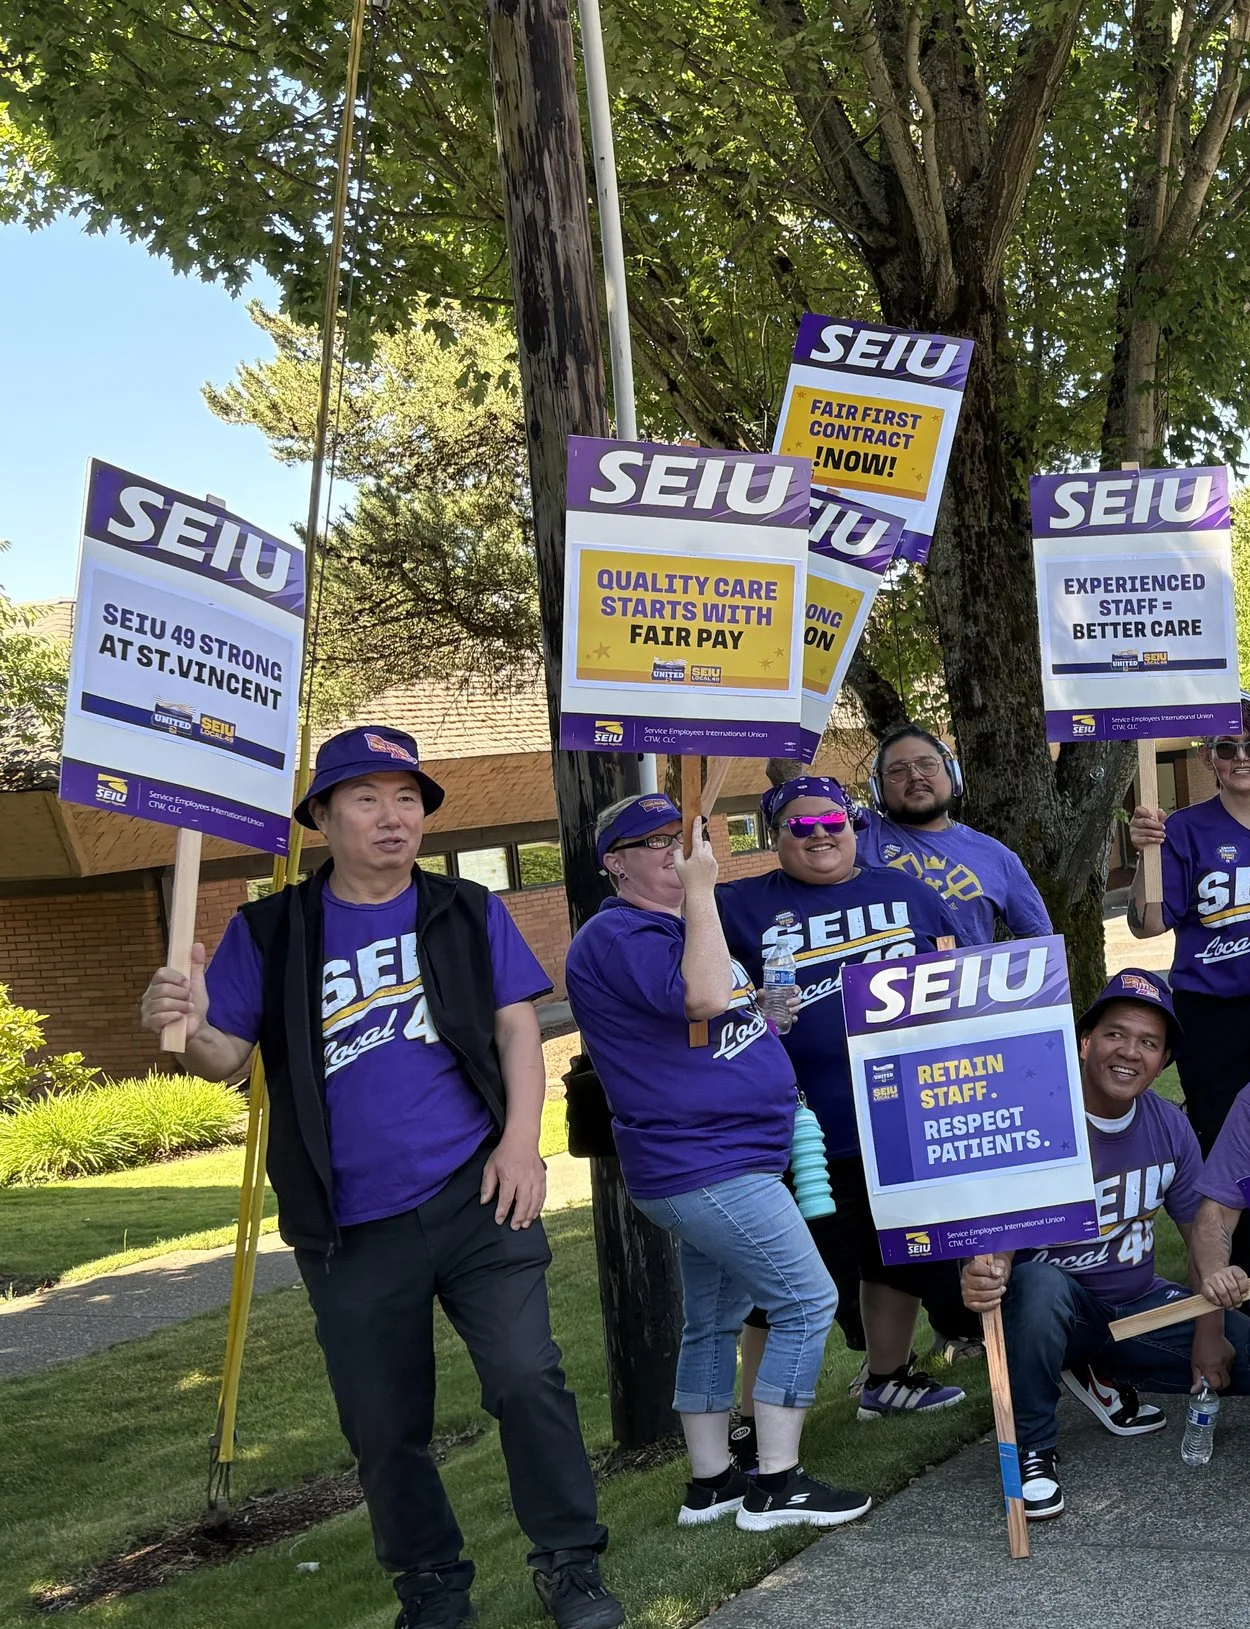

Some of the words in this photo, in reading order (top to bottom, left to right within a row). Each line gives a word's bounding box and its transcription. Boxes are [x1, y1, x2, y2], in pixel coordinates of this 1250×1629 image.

[809, 325, 960, 378] SEIU
[810, 399, 858, 420] FAIR
[861, 407, 922, 430] FIRST
[809, 421, 914, 450] CONTRACT
[814, 446, 897, 477] !NOW!
[590, 450, 793, 515] SEIU
[1050, 475, 1213, 530] SEIU
[107, 486, 291, 593] SEIU
[597, 569, 709, 595] QUALITY
[714, 578, 777, 600] CARE
[1064, 574, 1205, 594] EXPERIENCED
[601, 596, 697, 621] STARTS
[703, 603, 772, 626] WITH
[1099, 598, 1157, 616] STAFF
[103, 603, 166, 640] SEIU
[171, 625, 195, 649] 49
[199, 634, 282, 682] STRONG
[630, 624, 691, 646] FAIR
[697, 628, 744, 649] PAY
[1073, 622, 1146, 639] BETTER
[1150, 619, 1202, 637] CARE
[1144, 652, 1166, 661] SEIU
[99, 633, 133, 661] AT
[137, 645, 282, 710] ST.VINCENT
[692, 667, 720, 676] SEIU
[154, 714, 191, 729] UNITED
[201, 717, 234, 736] SEIU
[644, 727, 668, 735] Service
[669, 728, 704, 737] Employees
[706, 729, 746, 738] International
[1073, 726, 1095, 734] SEIU
[1131, 716, 1160, 724] Employees
[594, 733, 623, 742] SEIU
[96, 788, 127, 803] SEIU
[149, 791, 174, 802] Service
[175, 796, 210, 812] Employees
[211, 806, 247, 823] International
[247, 816, 264, 827] Union
[168, 805, 183, 814] CLC
[762, 902, 910, 959] SEIU
[322, 932, 421, 1019] SEI
[865, 947, 1048, 1024] SEIU
[917, 1053, 1004, 1085] RETAIN
[873, 1085, 898, 1096] SEIU
[920, 1081, 998, 1110] STAFF.
[924, 1106, 1024, 1140] RESPECT
[927, 1129, 1050, 1165] PATIENTS.
[1095, 1163, 1176, 1227] EIU
[947, 1231, 968, 1239] Service
[970, 1226, 1003, 1236] Employees
[1004, 1219, 1044, 1230] International
[1045, 1216, 1065, 1224] Union
[908, 1244, 930, 1254] SEIU
